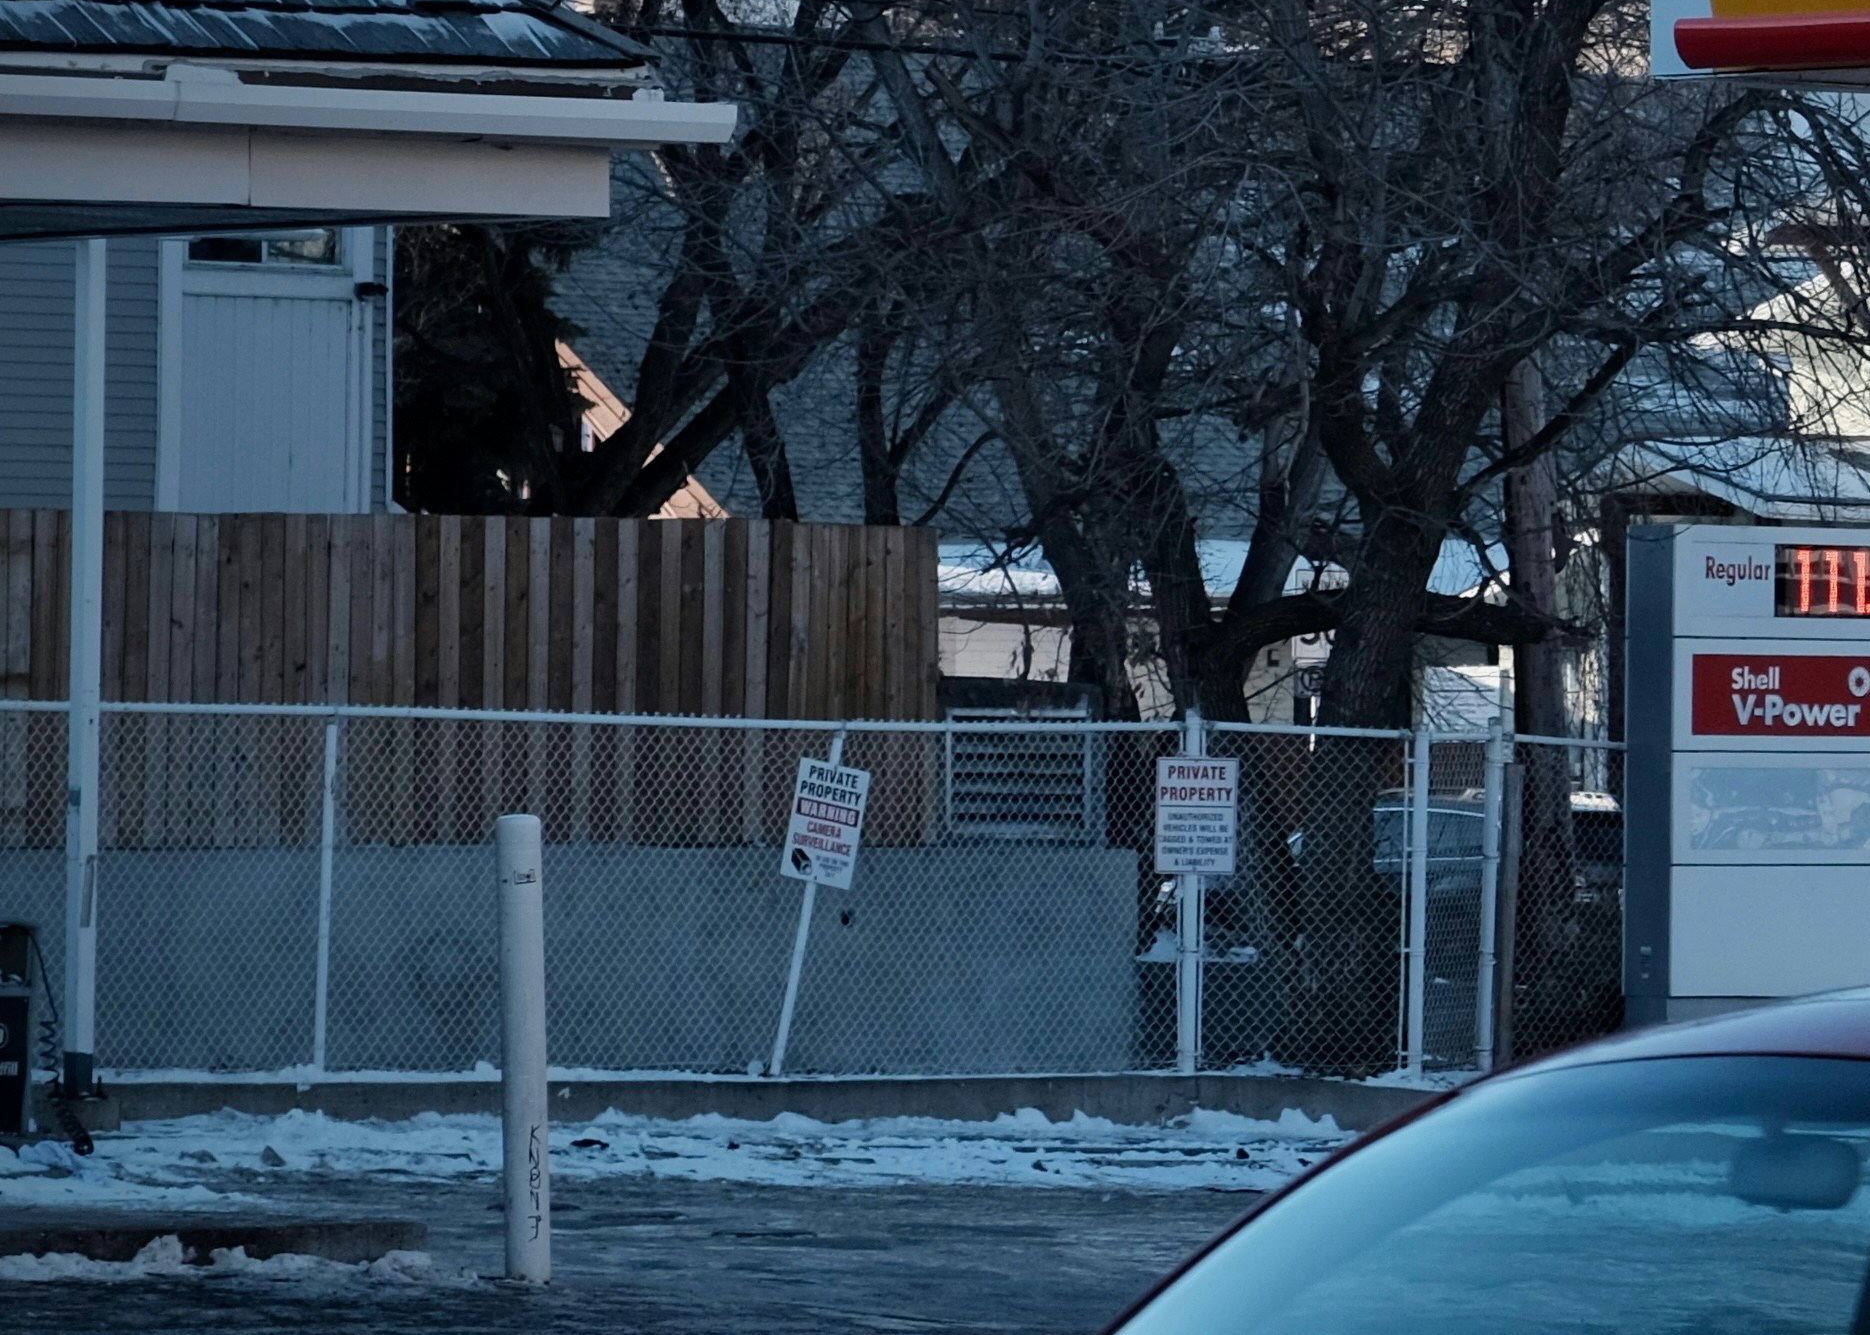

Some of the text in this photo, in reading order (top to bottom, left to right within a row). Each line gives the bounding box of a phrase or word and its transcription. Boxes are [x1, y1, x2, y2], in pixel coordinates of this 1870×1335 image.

[1705, 556, 1771, 587] Regular
[1731, 667, 1780, 691] Shell
[1732, 695, 1861, 727] V-Power
[808, 765, 859, 789] PRIVATE
[1168, 765, 1226, 780] PRIVATE
[800, 780, 862, 806] PROPERTY
[1161, 786, 1233, 801] PROPERTY
[800, 799, 857, 825] WARNING
[807, 821, 842, 839] CAMERA
[792, 832, 852, 857] SURVEILLANCE
